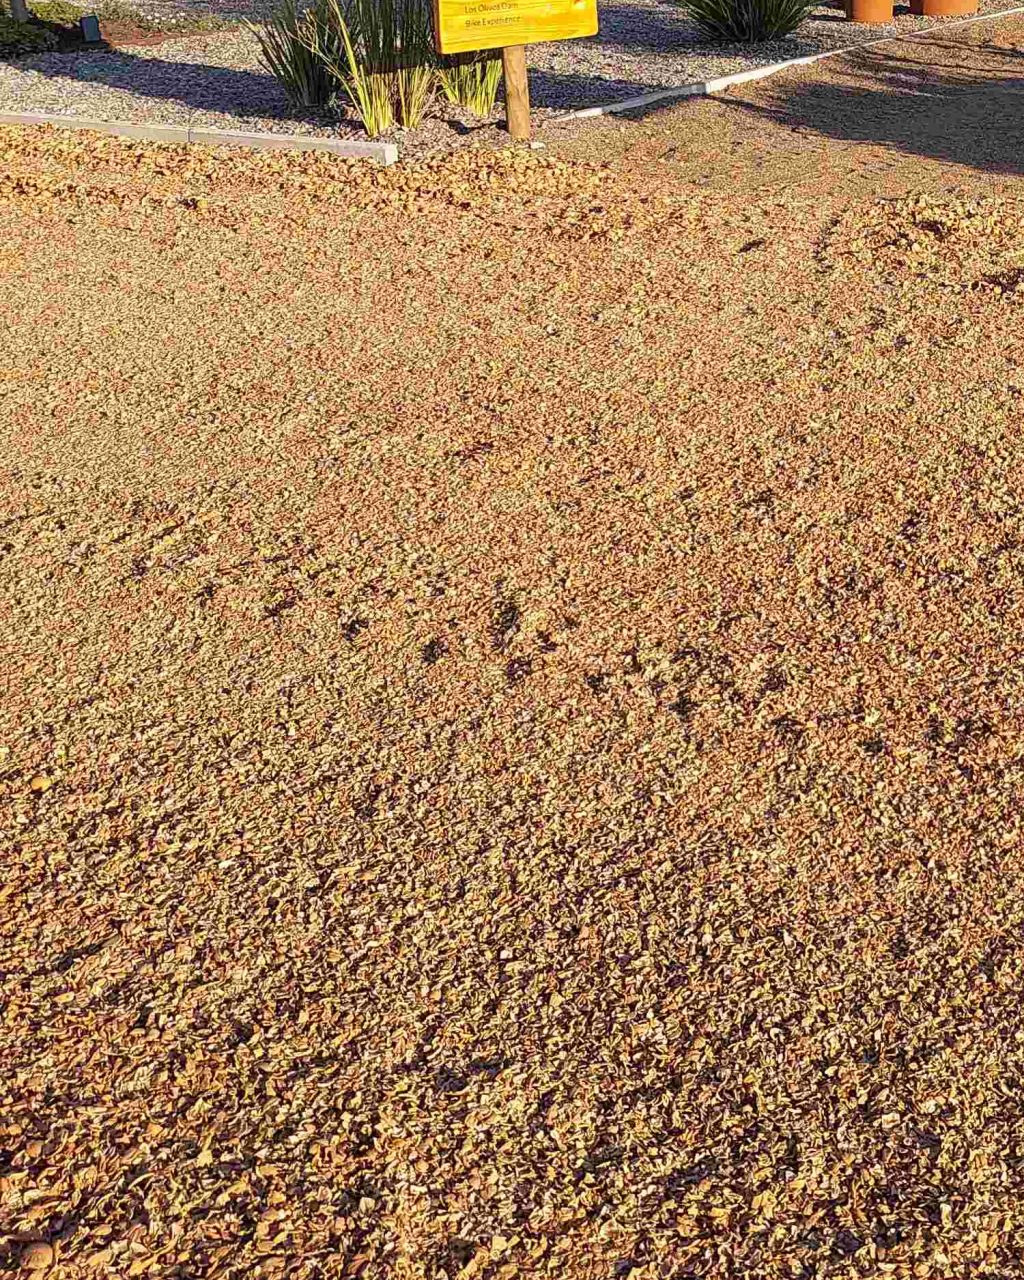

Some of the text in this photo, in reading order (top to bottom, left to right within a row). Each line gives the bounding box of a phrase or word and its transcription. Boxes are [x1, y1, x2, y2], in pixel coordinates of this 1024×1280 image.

[464, 5, 477, 14] Los
[478, 2, 501, 13] Olivos
[482, 15, 521, 27] Experience
